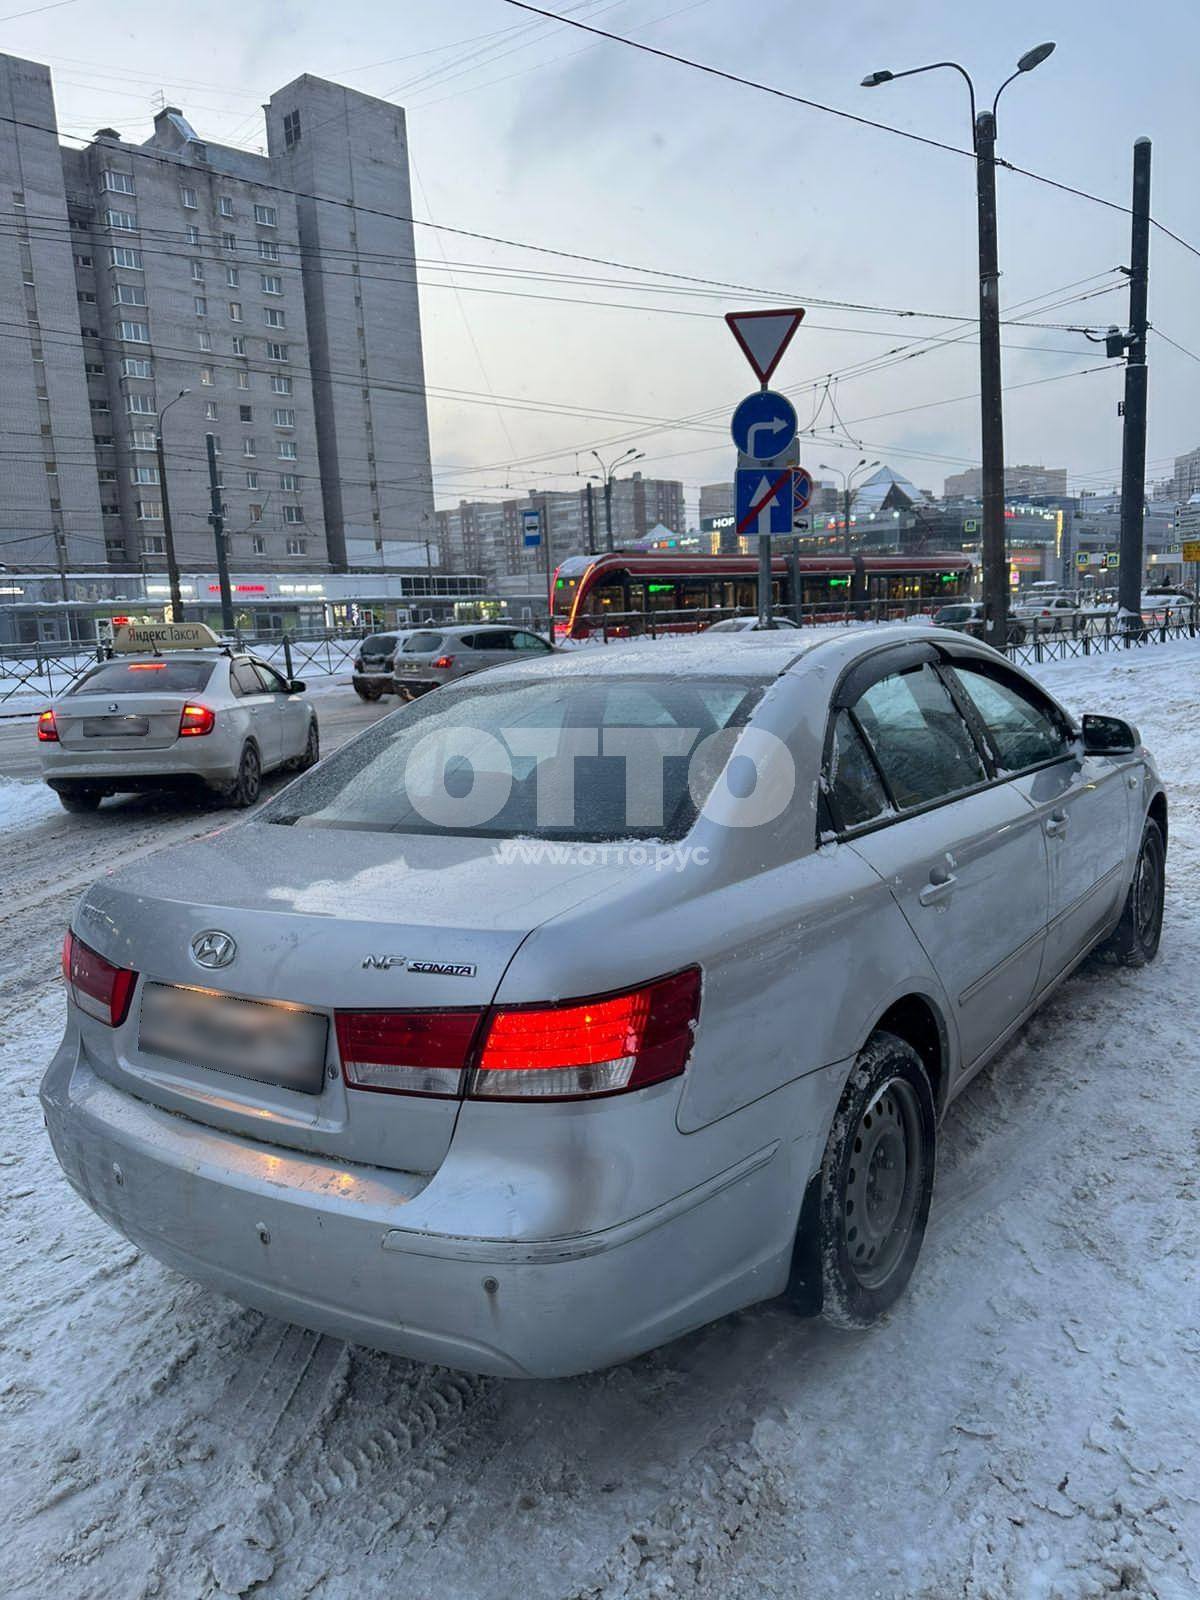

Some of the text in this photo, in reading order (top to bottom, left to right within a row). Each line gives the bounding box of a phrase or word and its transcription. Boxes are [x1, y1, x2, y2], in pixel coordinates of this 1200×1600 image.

[128, 627, 200, 643] Яндекс Такси
[362, 955, 472, 975] NF SONATA
